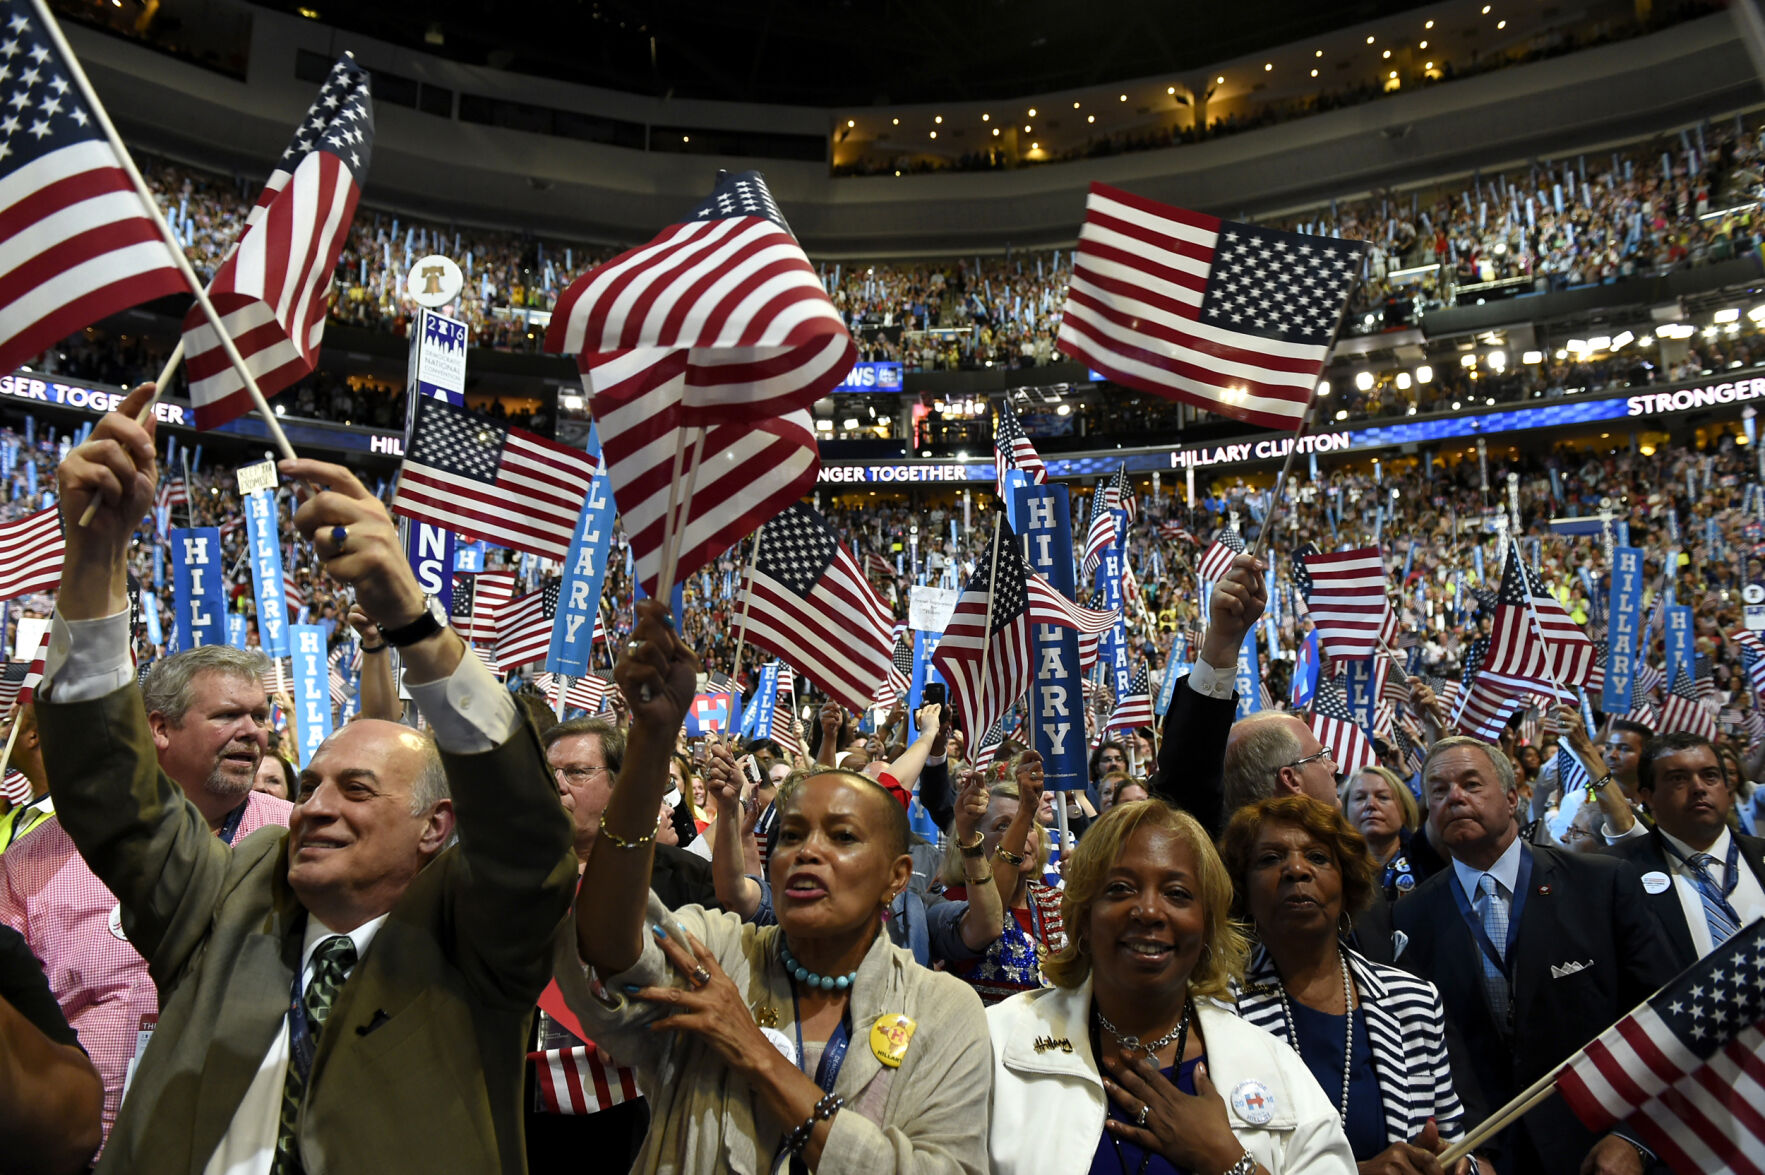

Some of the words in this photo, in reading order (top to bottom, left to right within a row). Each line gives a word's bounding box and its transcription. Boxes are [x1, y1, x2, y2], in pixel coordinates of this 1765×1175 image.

[53, 383, 184, 425] TOGEER
[1627, 378, 1765, 416] STRONGER
[1170, 443, 1252, 468] HILLARY
[1255, 431, 1350, 459] CLINTON
[869, 465, 967, 482] TOGETHER
[251, 500, 282, 639] HILLARY
[1027, 497, 1071, 755] HILARY
[1612, 553, 1637, 695] HILLARY
